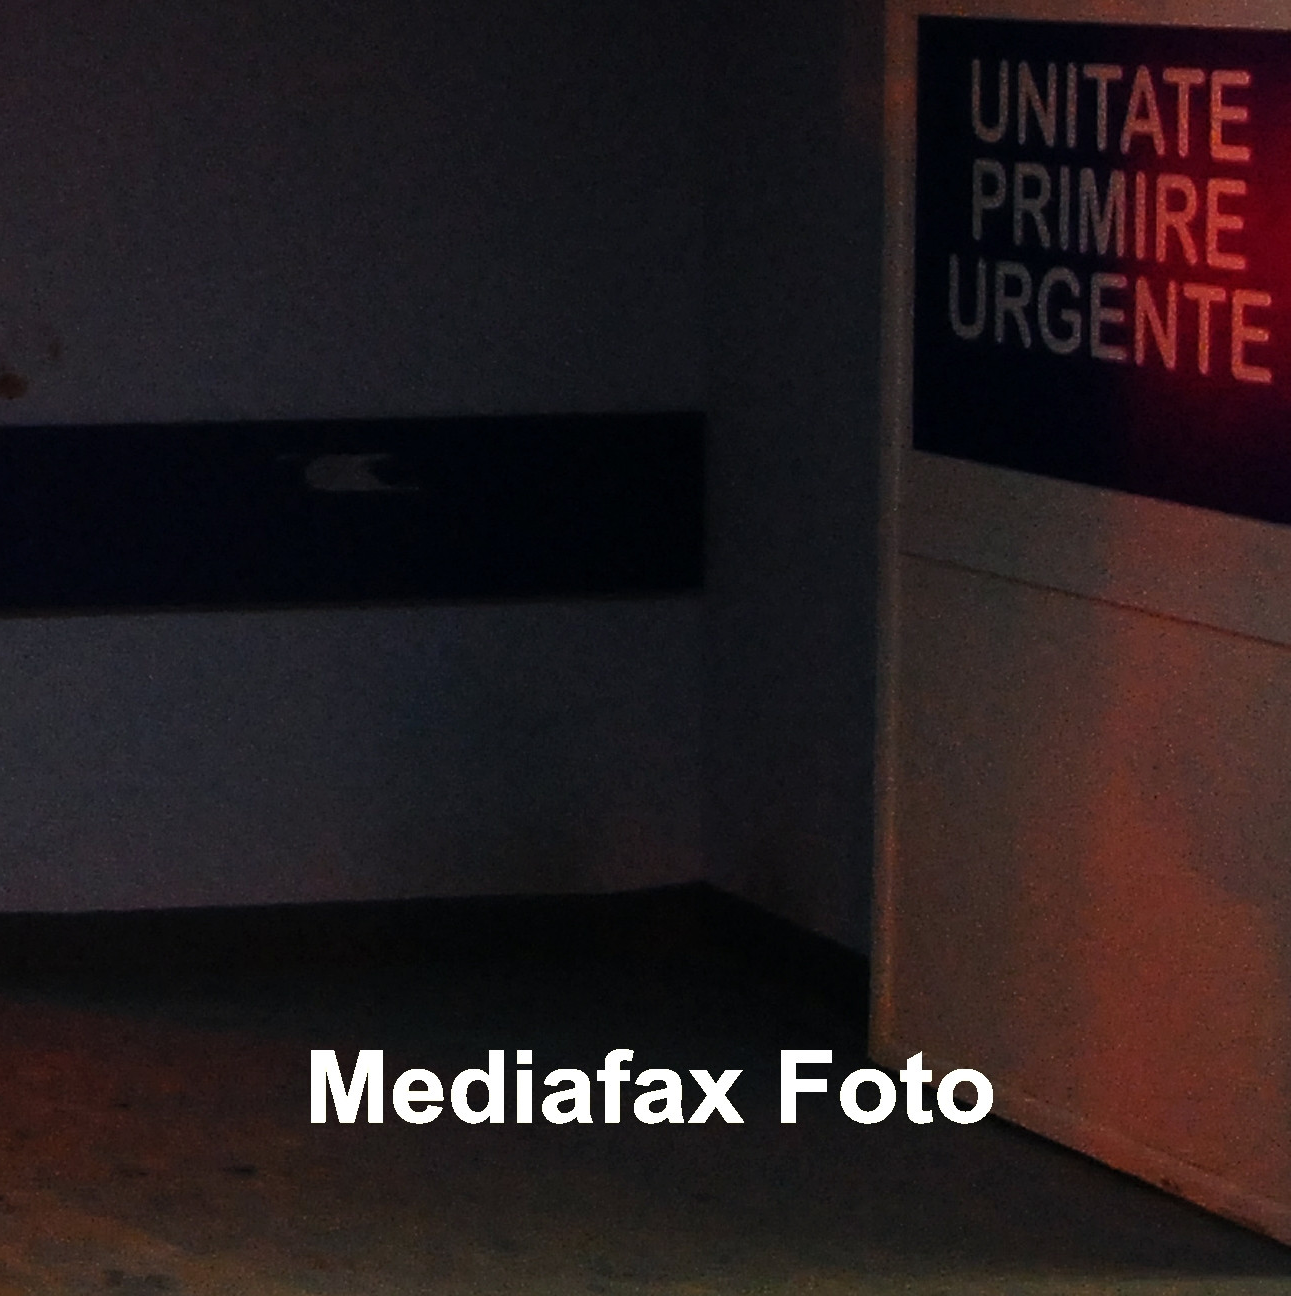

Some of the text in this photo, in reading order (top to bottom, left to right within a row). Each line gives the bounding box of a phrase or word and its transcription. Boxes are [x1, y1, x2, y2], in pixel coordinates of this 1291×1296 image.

[970, 57, 1253, 162] UNITATE
[970, 157, 1248, 272] PRIMIRE
[947, 252, 1274, 385] URGENTE
